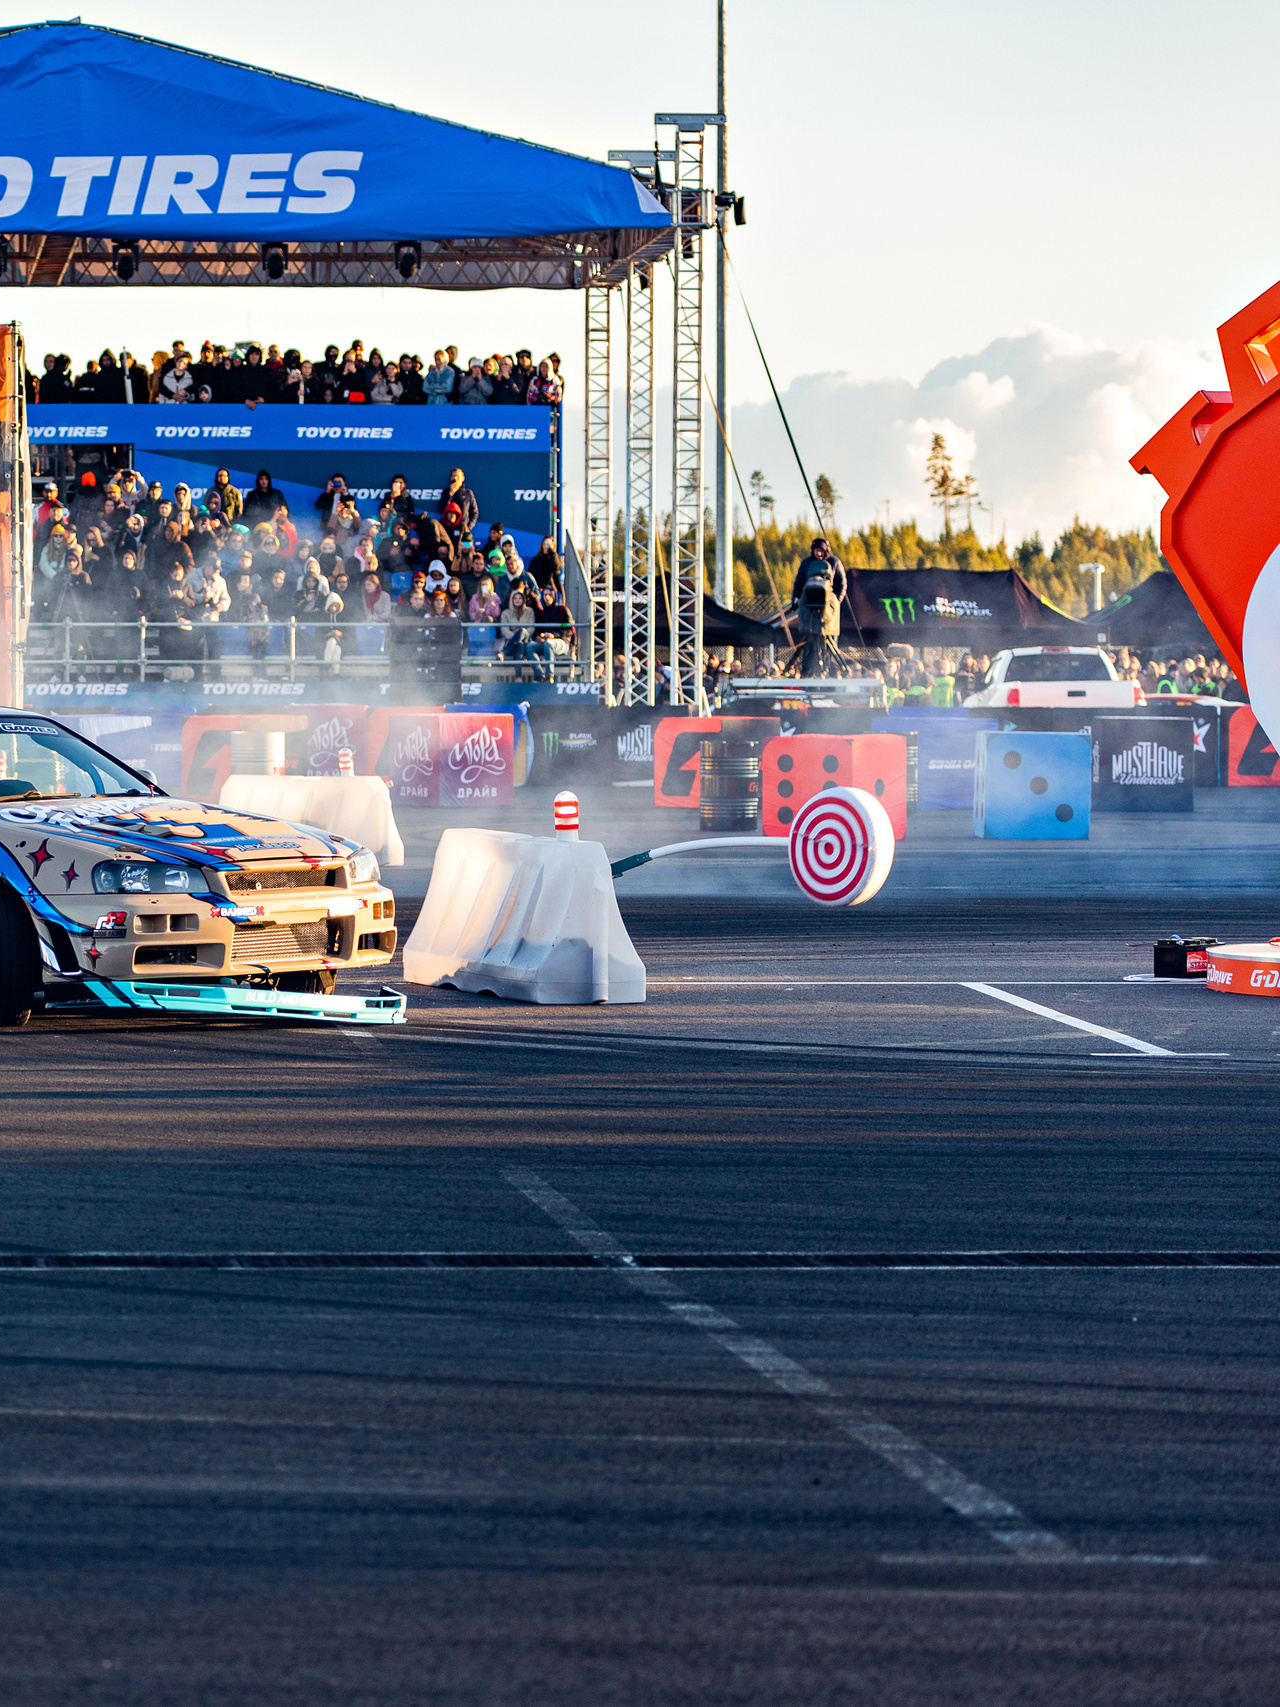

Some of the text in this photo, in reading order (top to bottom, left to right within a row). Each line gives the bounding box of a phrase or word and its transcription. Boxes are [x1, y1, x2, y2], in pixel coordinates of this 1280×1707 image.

[50, 151, 363, 216] TIRES
[58, 426, 109, 437] TIRES
[156, 427, 252, 438] TOYO TIRES
[297, 427, 394, 438] TOYO TIRES
[441, 428, 537, 439] TOYO TIRES
[409, 489, 443, 500] RES
[26, 683, 129, 695] TOYO TIRES
[203, 683, 306, 695] TOYO TIRES
[399, 785, 428, 798] ДРАЙВ
[456, 785, 498, 798] ДРАЙВ
[220, 907, 258, 917] BANNED
[245, 992, 276, 1003] BUILD
